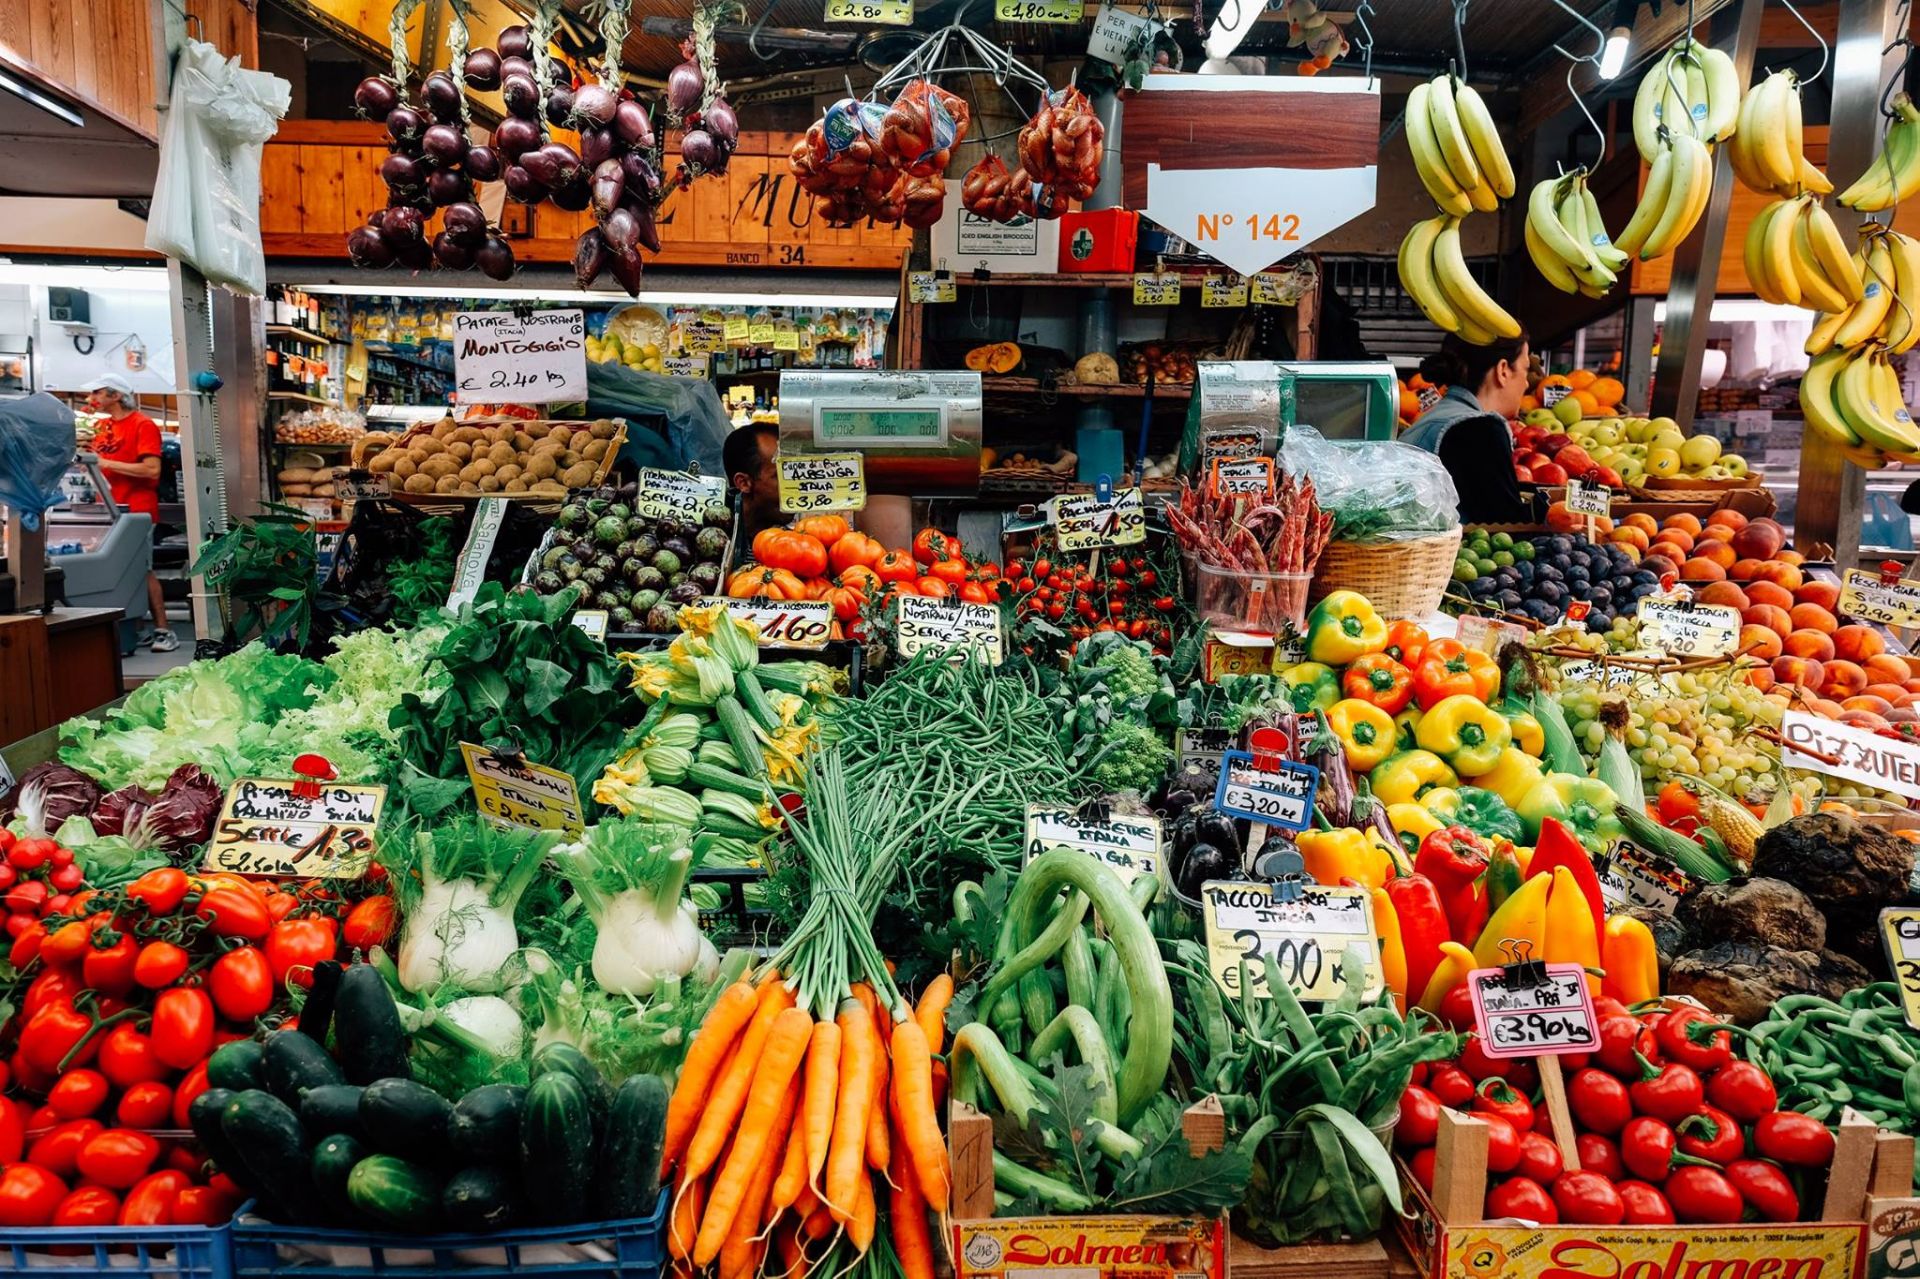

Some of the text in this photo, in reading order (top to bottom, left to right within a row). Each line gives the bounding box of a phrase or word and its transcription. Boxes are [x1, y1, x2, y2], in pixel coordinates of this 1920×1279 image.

[1107, 15, 1126, 29] PER
[1105, 43, 1115, 54] LA
[1197, 214, 1300, 240] N° 142
[726, 253, 760, 264] BANCO
[456, 313, 583, 331] PATATE NOSTRANE
[489, 370, 538, 388] 2.40
[462, 522, 497, 589] Salanova
[1886, 1210, 1914, 1224] TOP
[1003, 1233, 1167, 1266] Dolmen
[1506, 1233, 1545, 1257] PRODOTTO
[1511, 1239, 1545, 1260] ITALIANO
[1537, 1239, 1826, 1279] Dolmen
